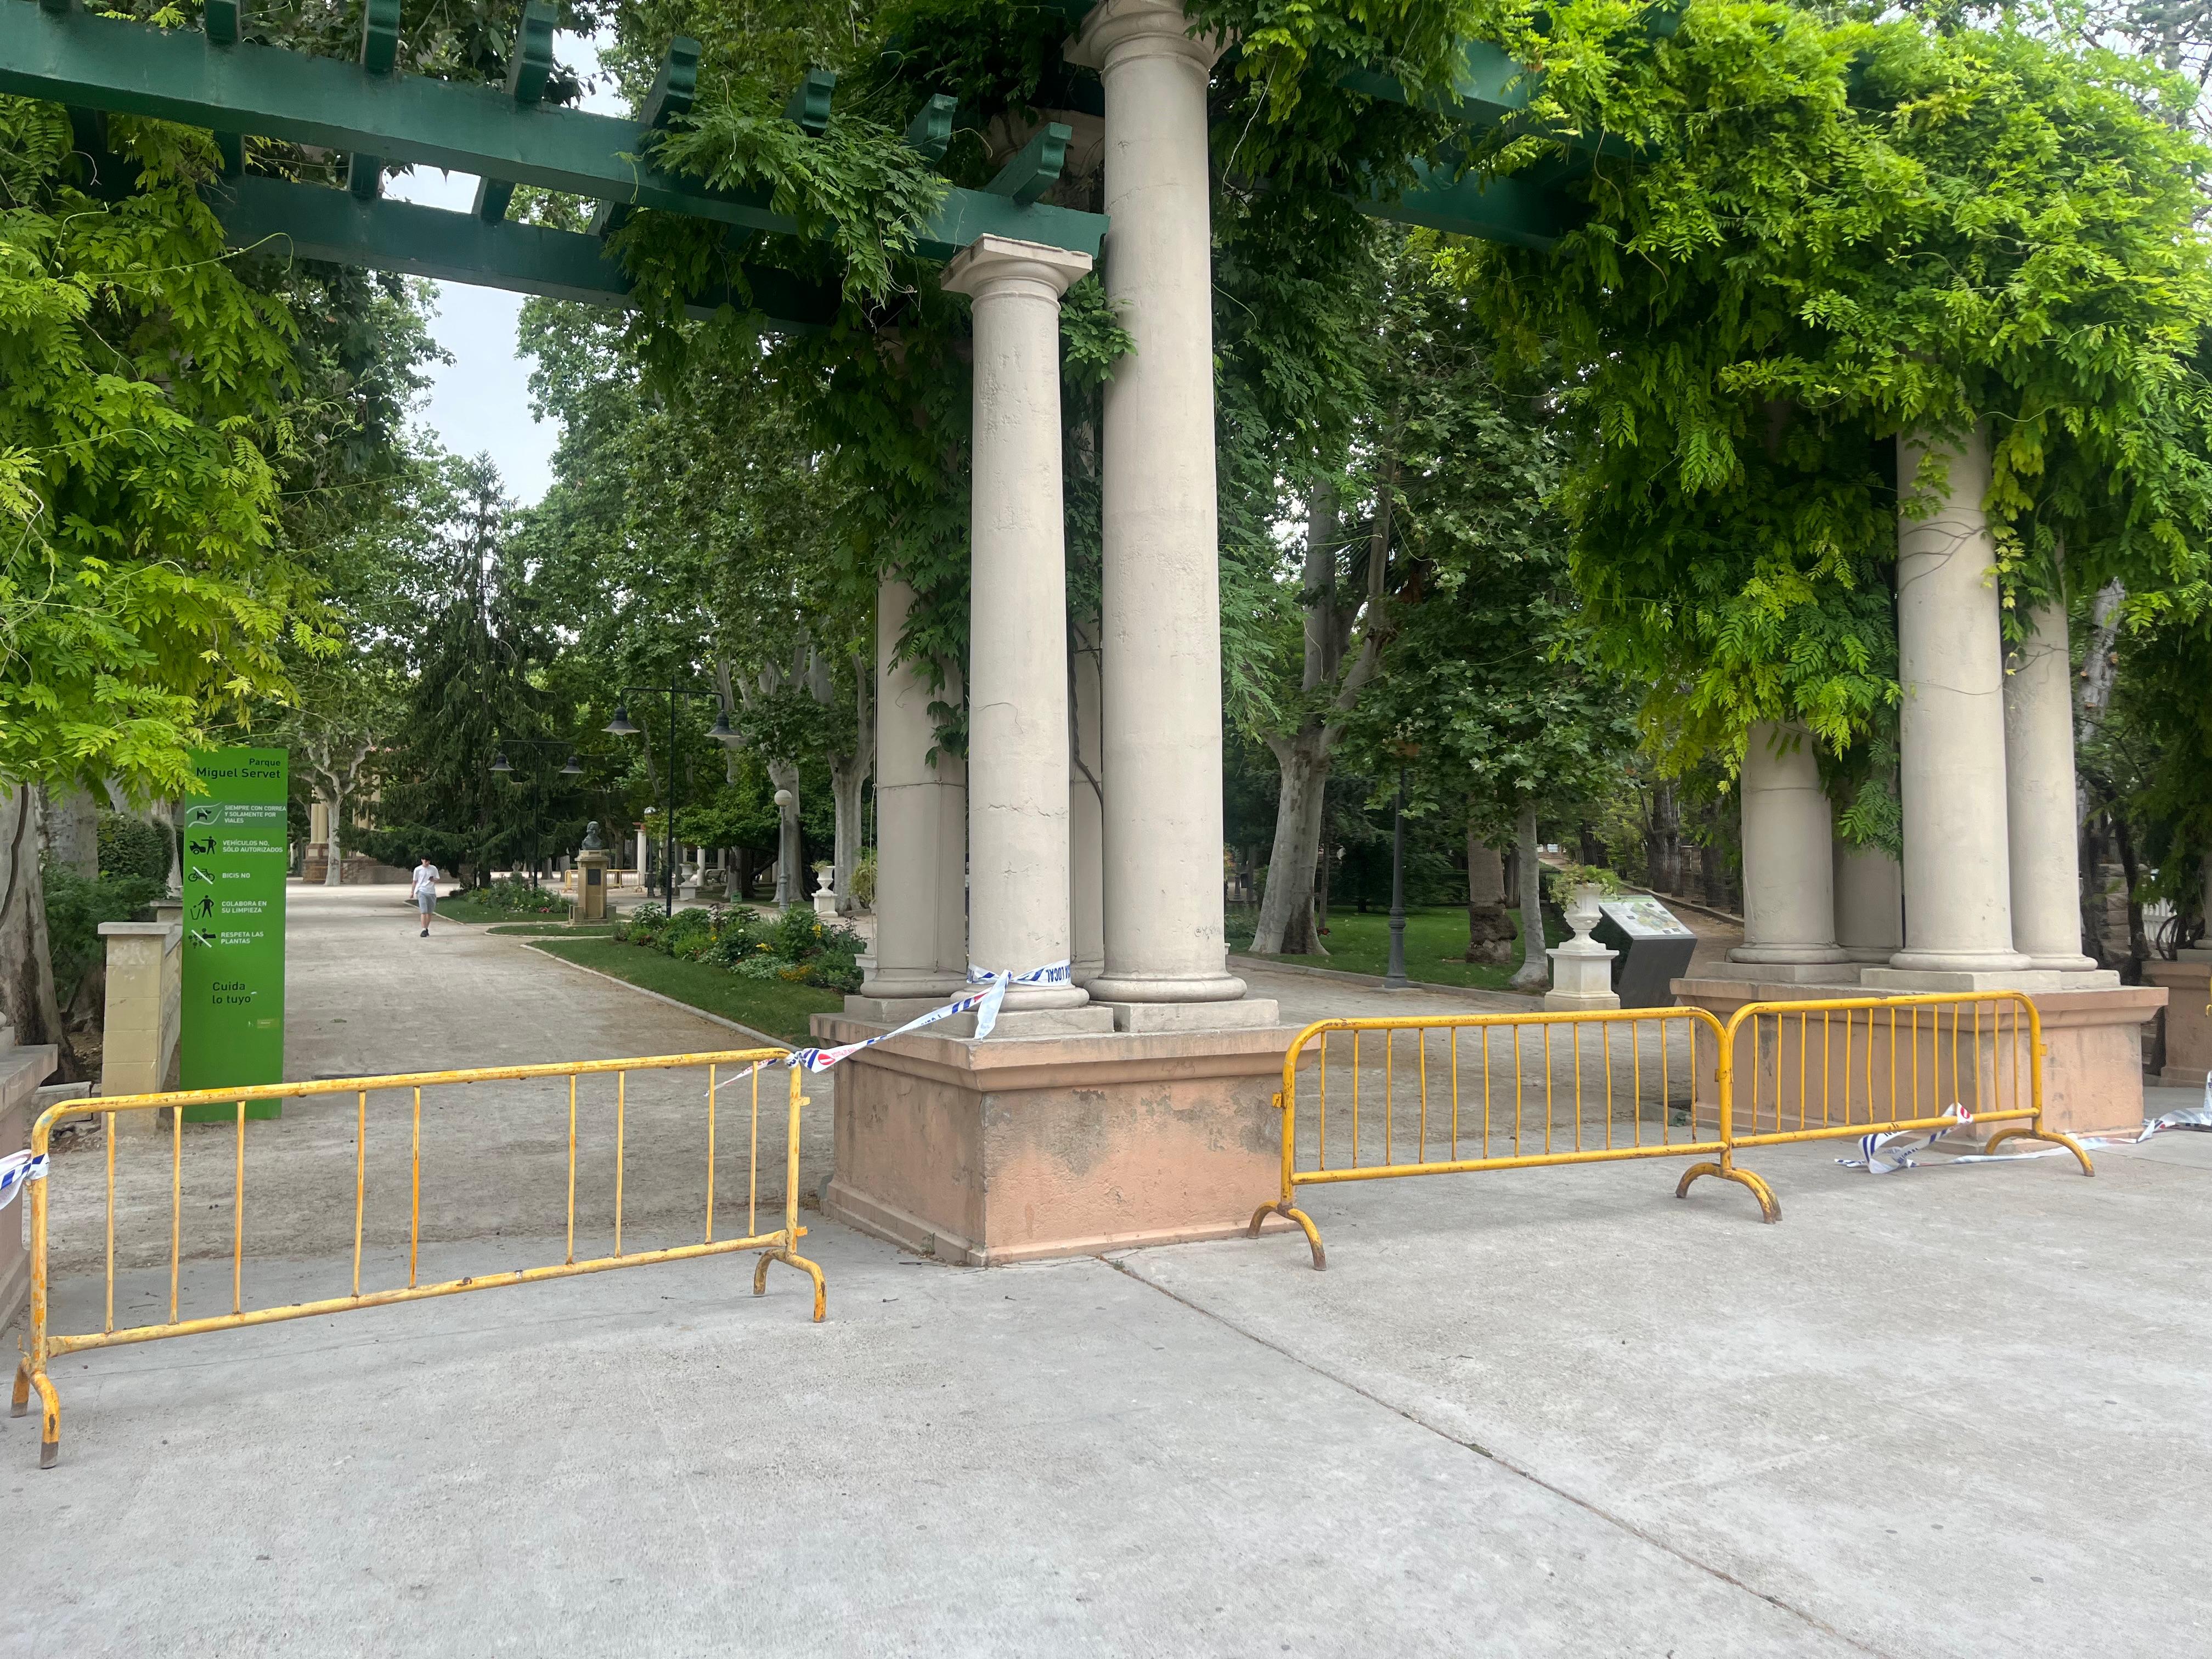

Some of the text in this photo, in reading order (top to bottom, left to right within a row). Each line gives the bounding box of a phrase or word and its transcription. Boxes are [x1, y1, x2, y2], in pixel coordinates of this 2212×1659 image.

[249, 758, 281, 767] Parque
[196, 767, 280, 779] Miguel Servet
[213, 981, 245, 991] Cuida
[212, 995, 251, 1005] lo tuyo
